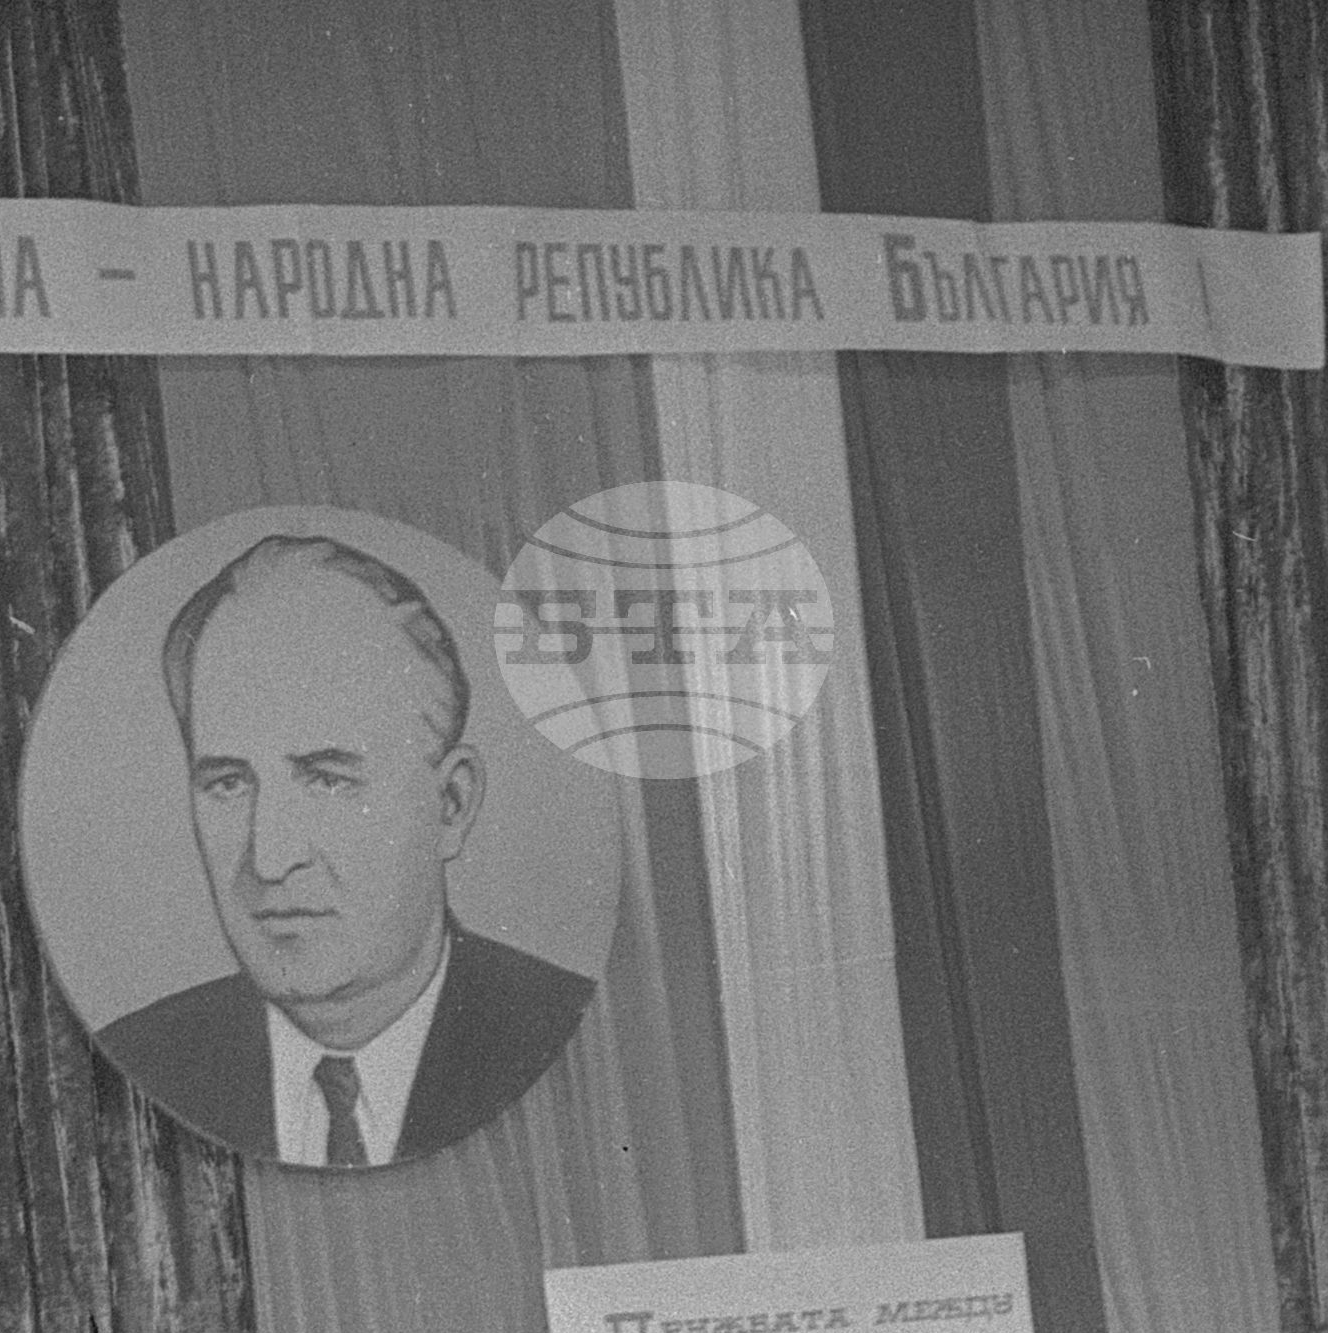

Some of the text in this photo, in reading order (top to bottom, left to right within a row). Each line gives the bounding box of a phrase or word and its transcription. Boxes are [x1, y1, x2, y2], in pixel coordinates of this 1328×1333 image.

[186, 238, 458, 320] НАРОДНА
[515, 241, 825, 323] РЕПУБЛИКА
[883, 232, 1150, 327] БЪЛГАРИЯ
[874, 1292, 1015, 1325] МЕЖДУ
